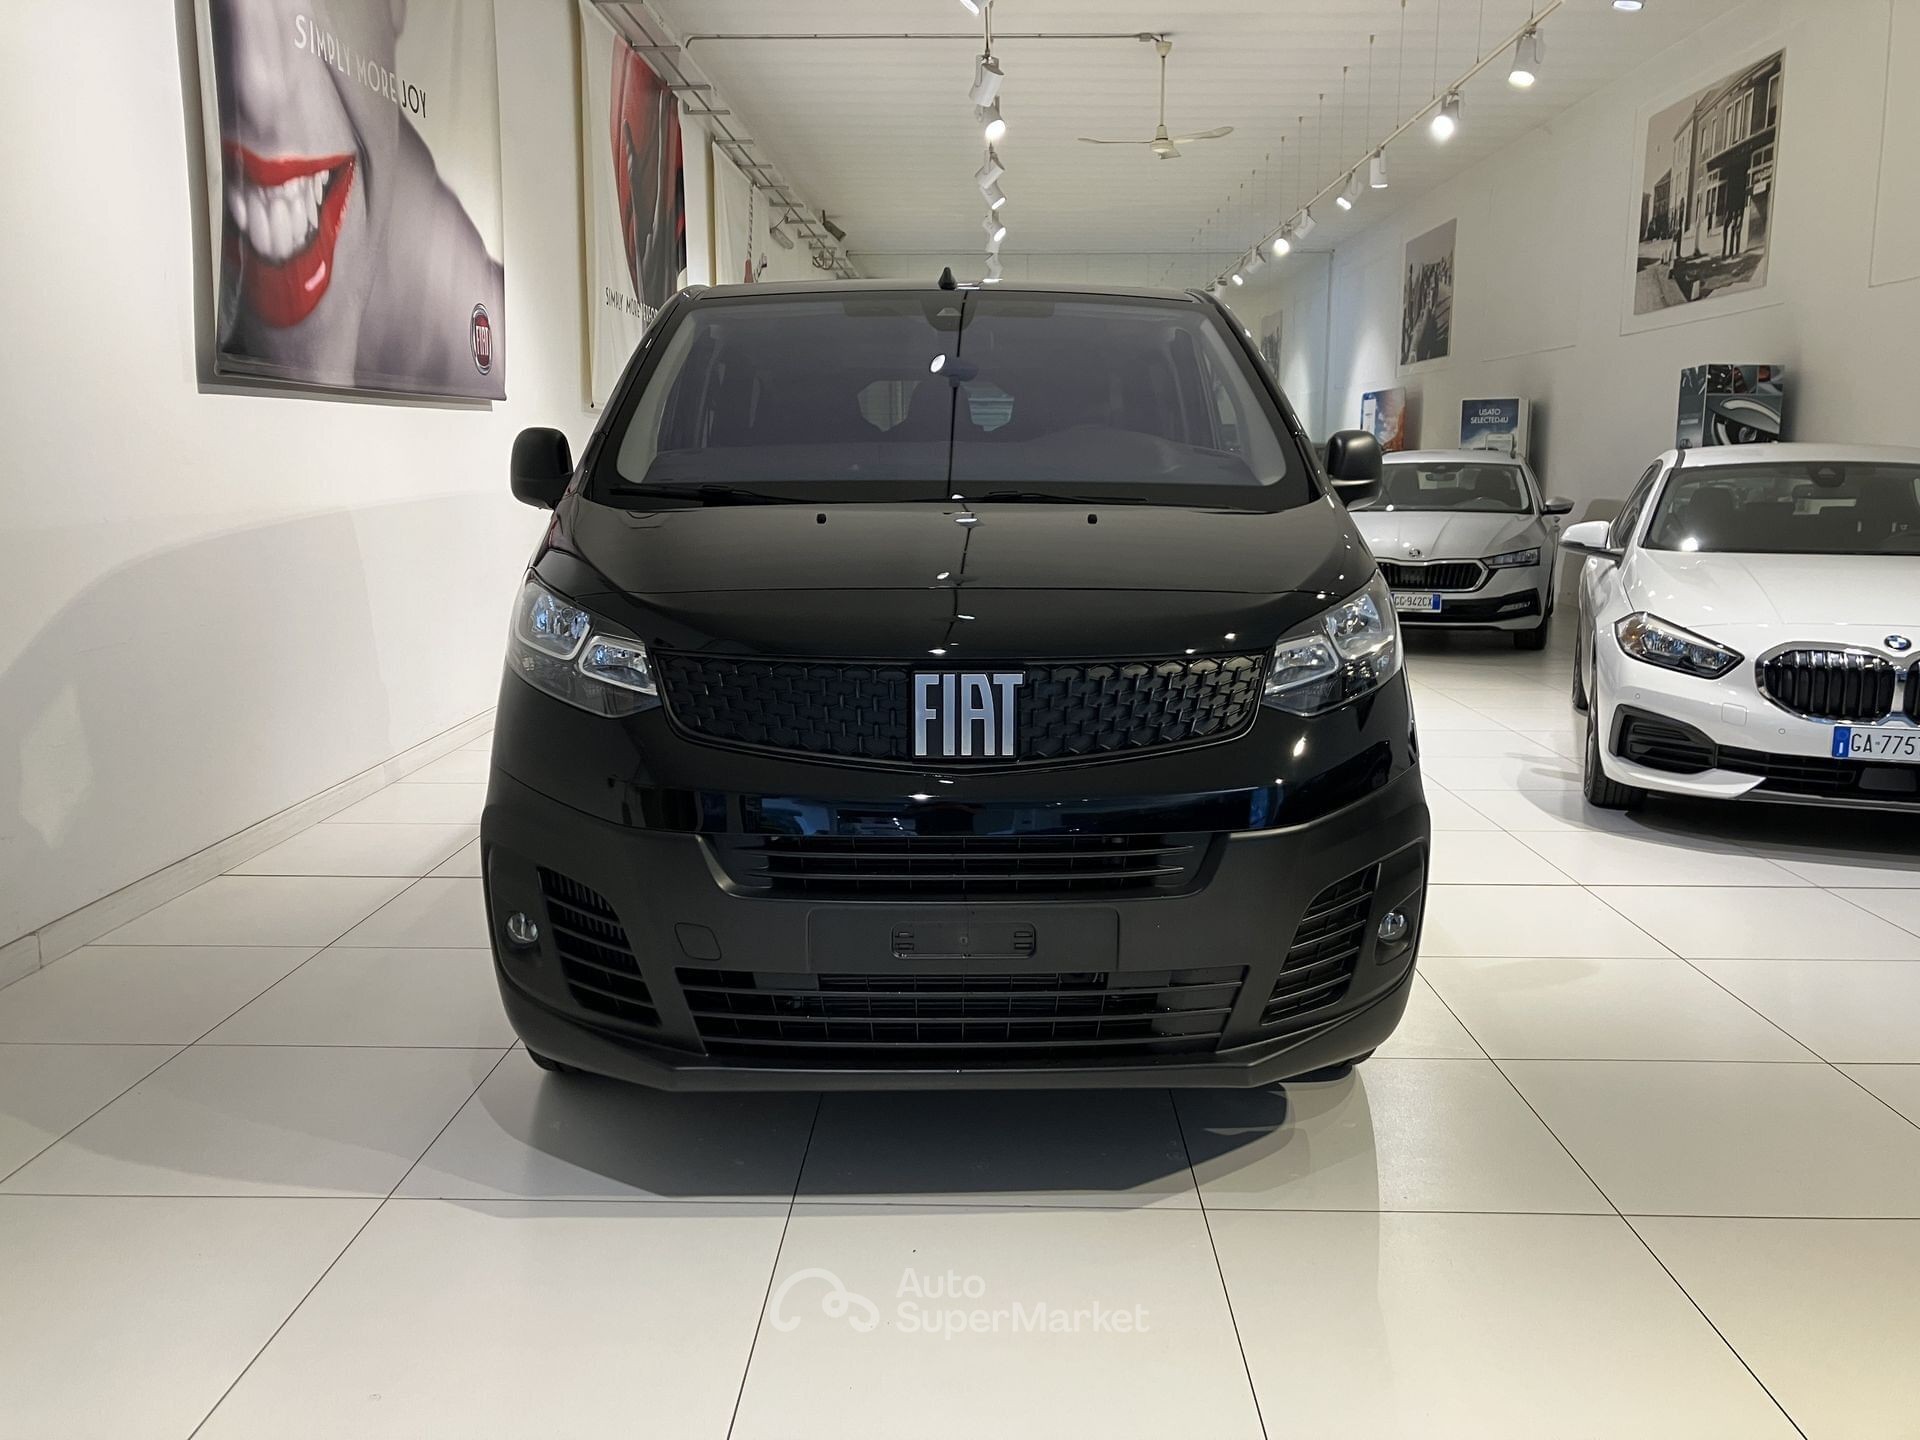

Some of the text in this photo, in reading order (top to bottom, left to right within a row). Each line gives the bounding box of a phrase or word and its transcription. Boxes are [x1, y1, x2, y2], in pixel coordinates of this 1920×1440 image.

[294, 14, 426, 118] SIMPLY MORE JOY
[605, 286, 624, 312] SIMPLY
[626, 296, 640, 318] MORE
[475, 325, 489, 356] FIAT
[1478, 408, 1501, 416] USATO
[914, 673, 1023, 756] FIAT
